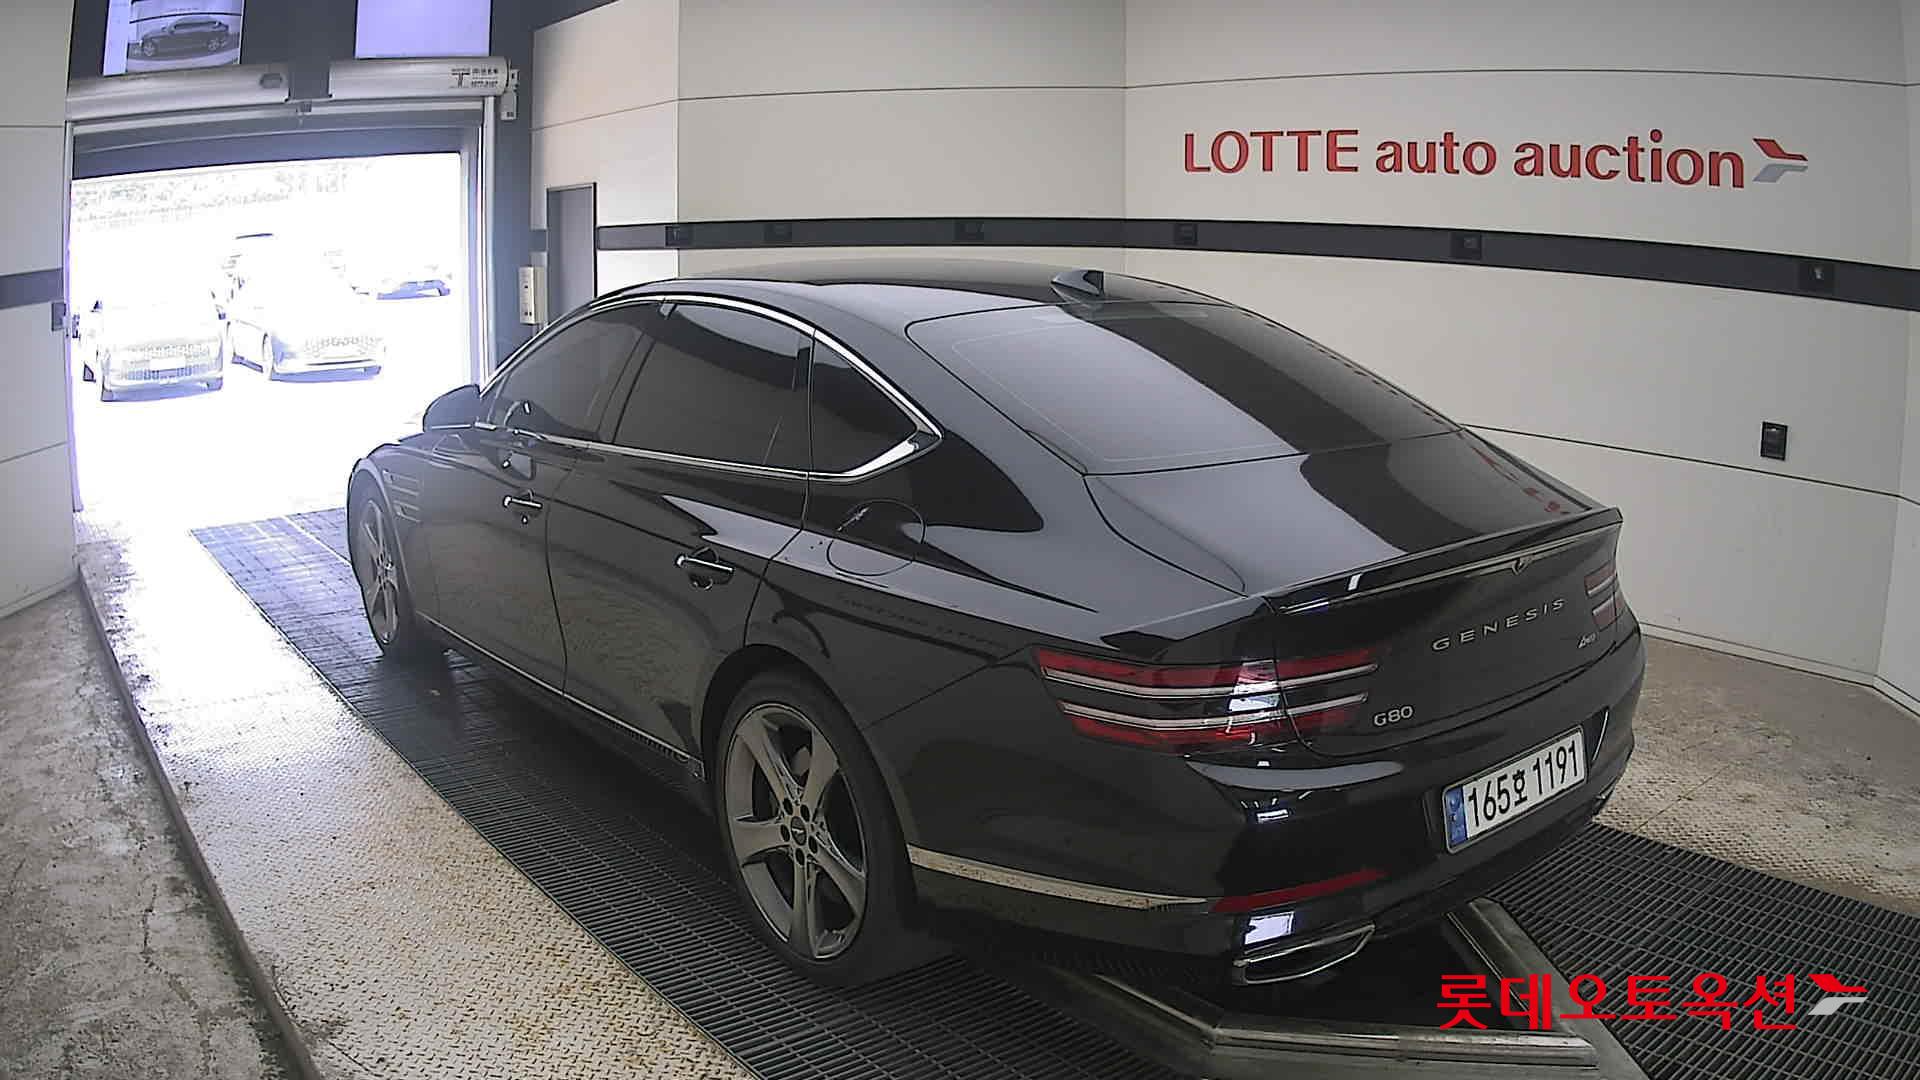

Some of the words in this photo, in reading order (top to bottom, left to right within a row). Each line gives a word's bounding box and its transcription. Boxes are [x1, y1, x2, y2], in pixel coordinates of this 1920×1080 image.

[1184, 128, 1360, 174] LOTTE
[1375, 131, 1498, 176] auto
[1513, 129, 1745, 189] auction
[1431, 598, 1566, 652] GENESIS
[1373, 704, 1415, 728] G80
[1467, 768, 1529, 828] 165호
[1532, 739, 1579, 796] 1191
